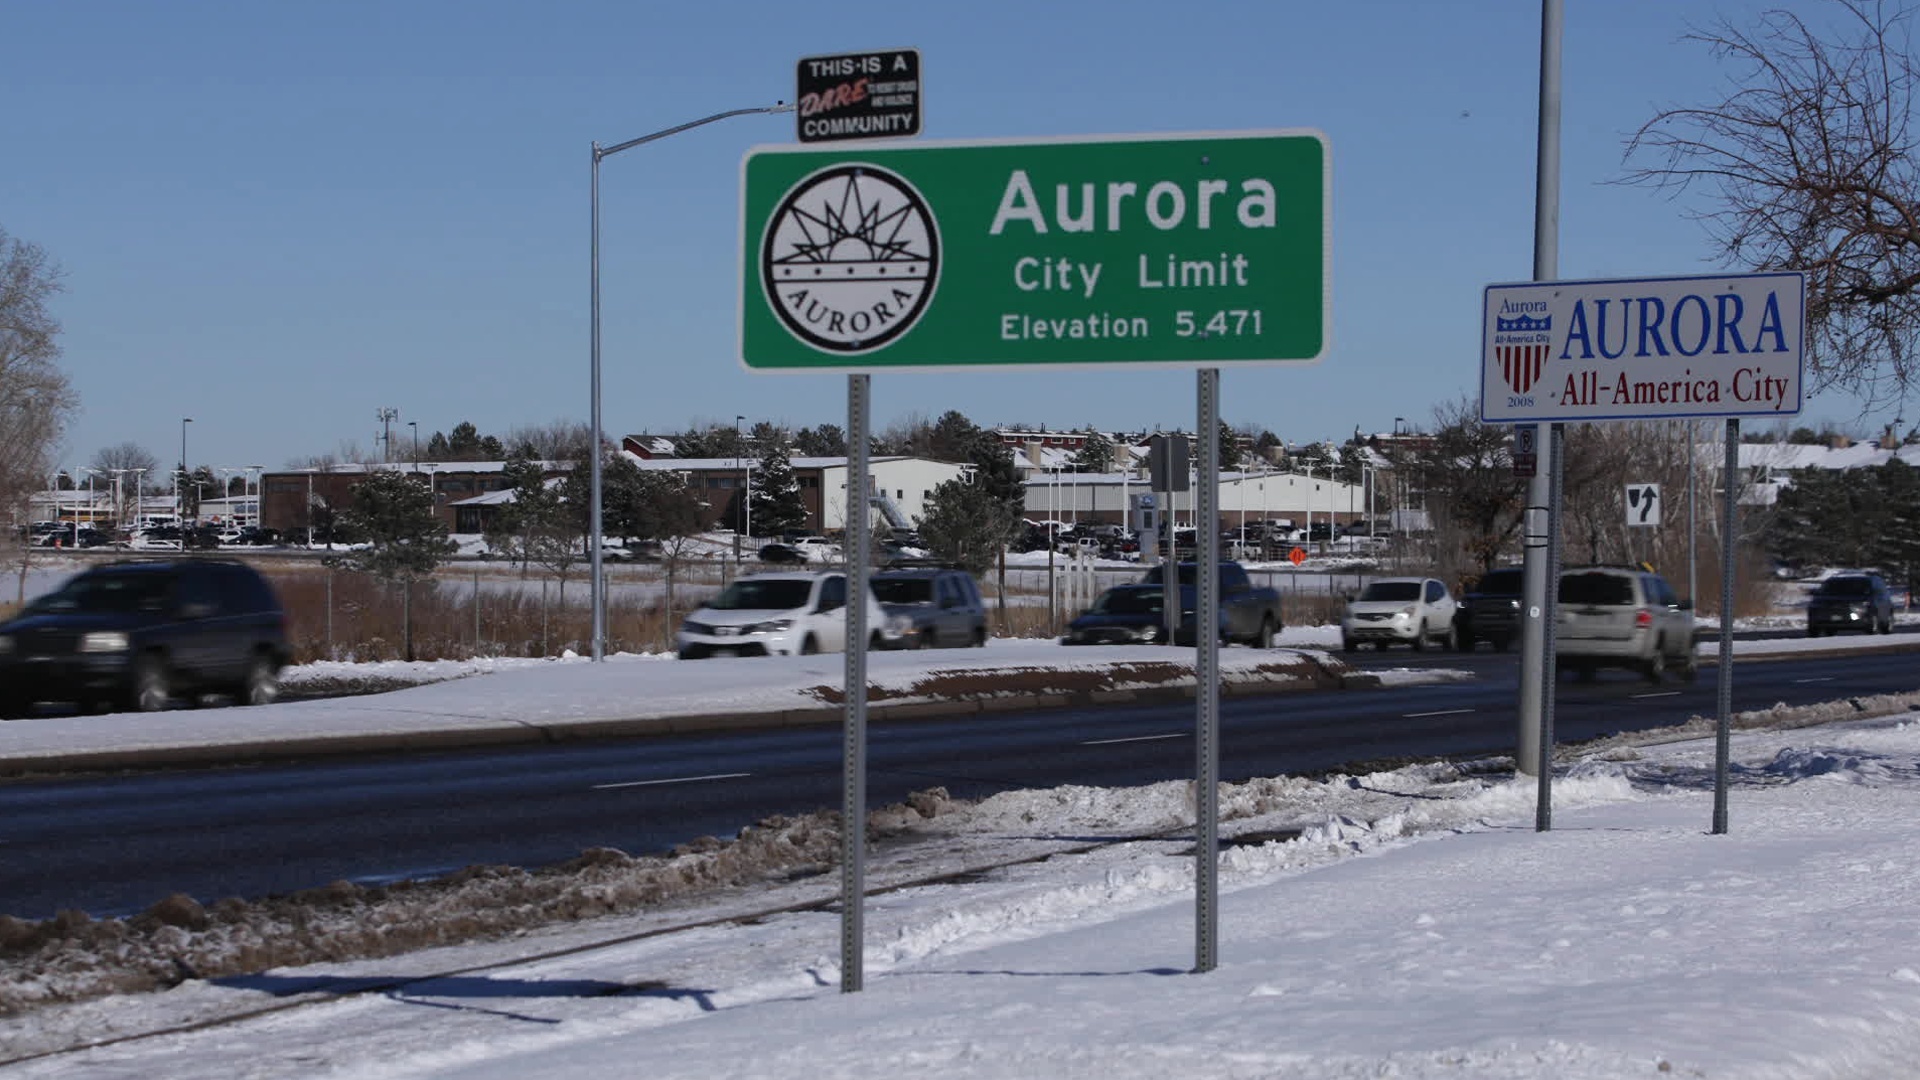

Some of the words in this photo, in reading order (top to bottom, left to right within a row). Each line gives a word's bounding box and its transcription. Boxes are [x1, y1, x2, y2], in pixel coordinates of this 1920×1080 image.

[809, 59, 855, 77] THIS
[860, 57, 881, 73] IS
[892, 54, 907, 71] A
[804, 113, 912, 137] COMMUNITY
[989, 169, 1276, 235] Aurora
[1015, 256, 1101, 298] City
[1139, 253, 1248, 288] Limit
[787, 288, 913, 335] AURORA
[1500, 297, 1547, 313] Aurora
[1001, 313, 1148, 340] Elevation
[1559, 290, 1790, 360] AURORA
[1495, 335, 1534, 344] All-America
[1536, 334, 1550, 344] City
[1508, 396, 1535, 408] 2008
[1560, 369, 1719, 406] All-America
[1732, 367, 1789, 411] City
